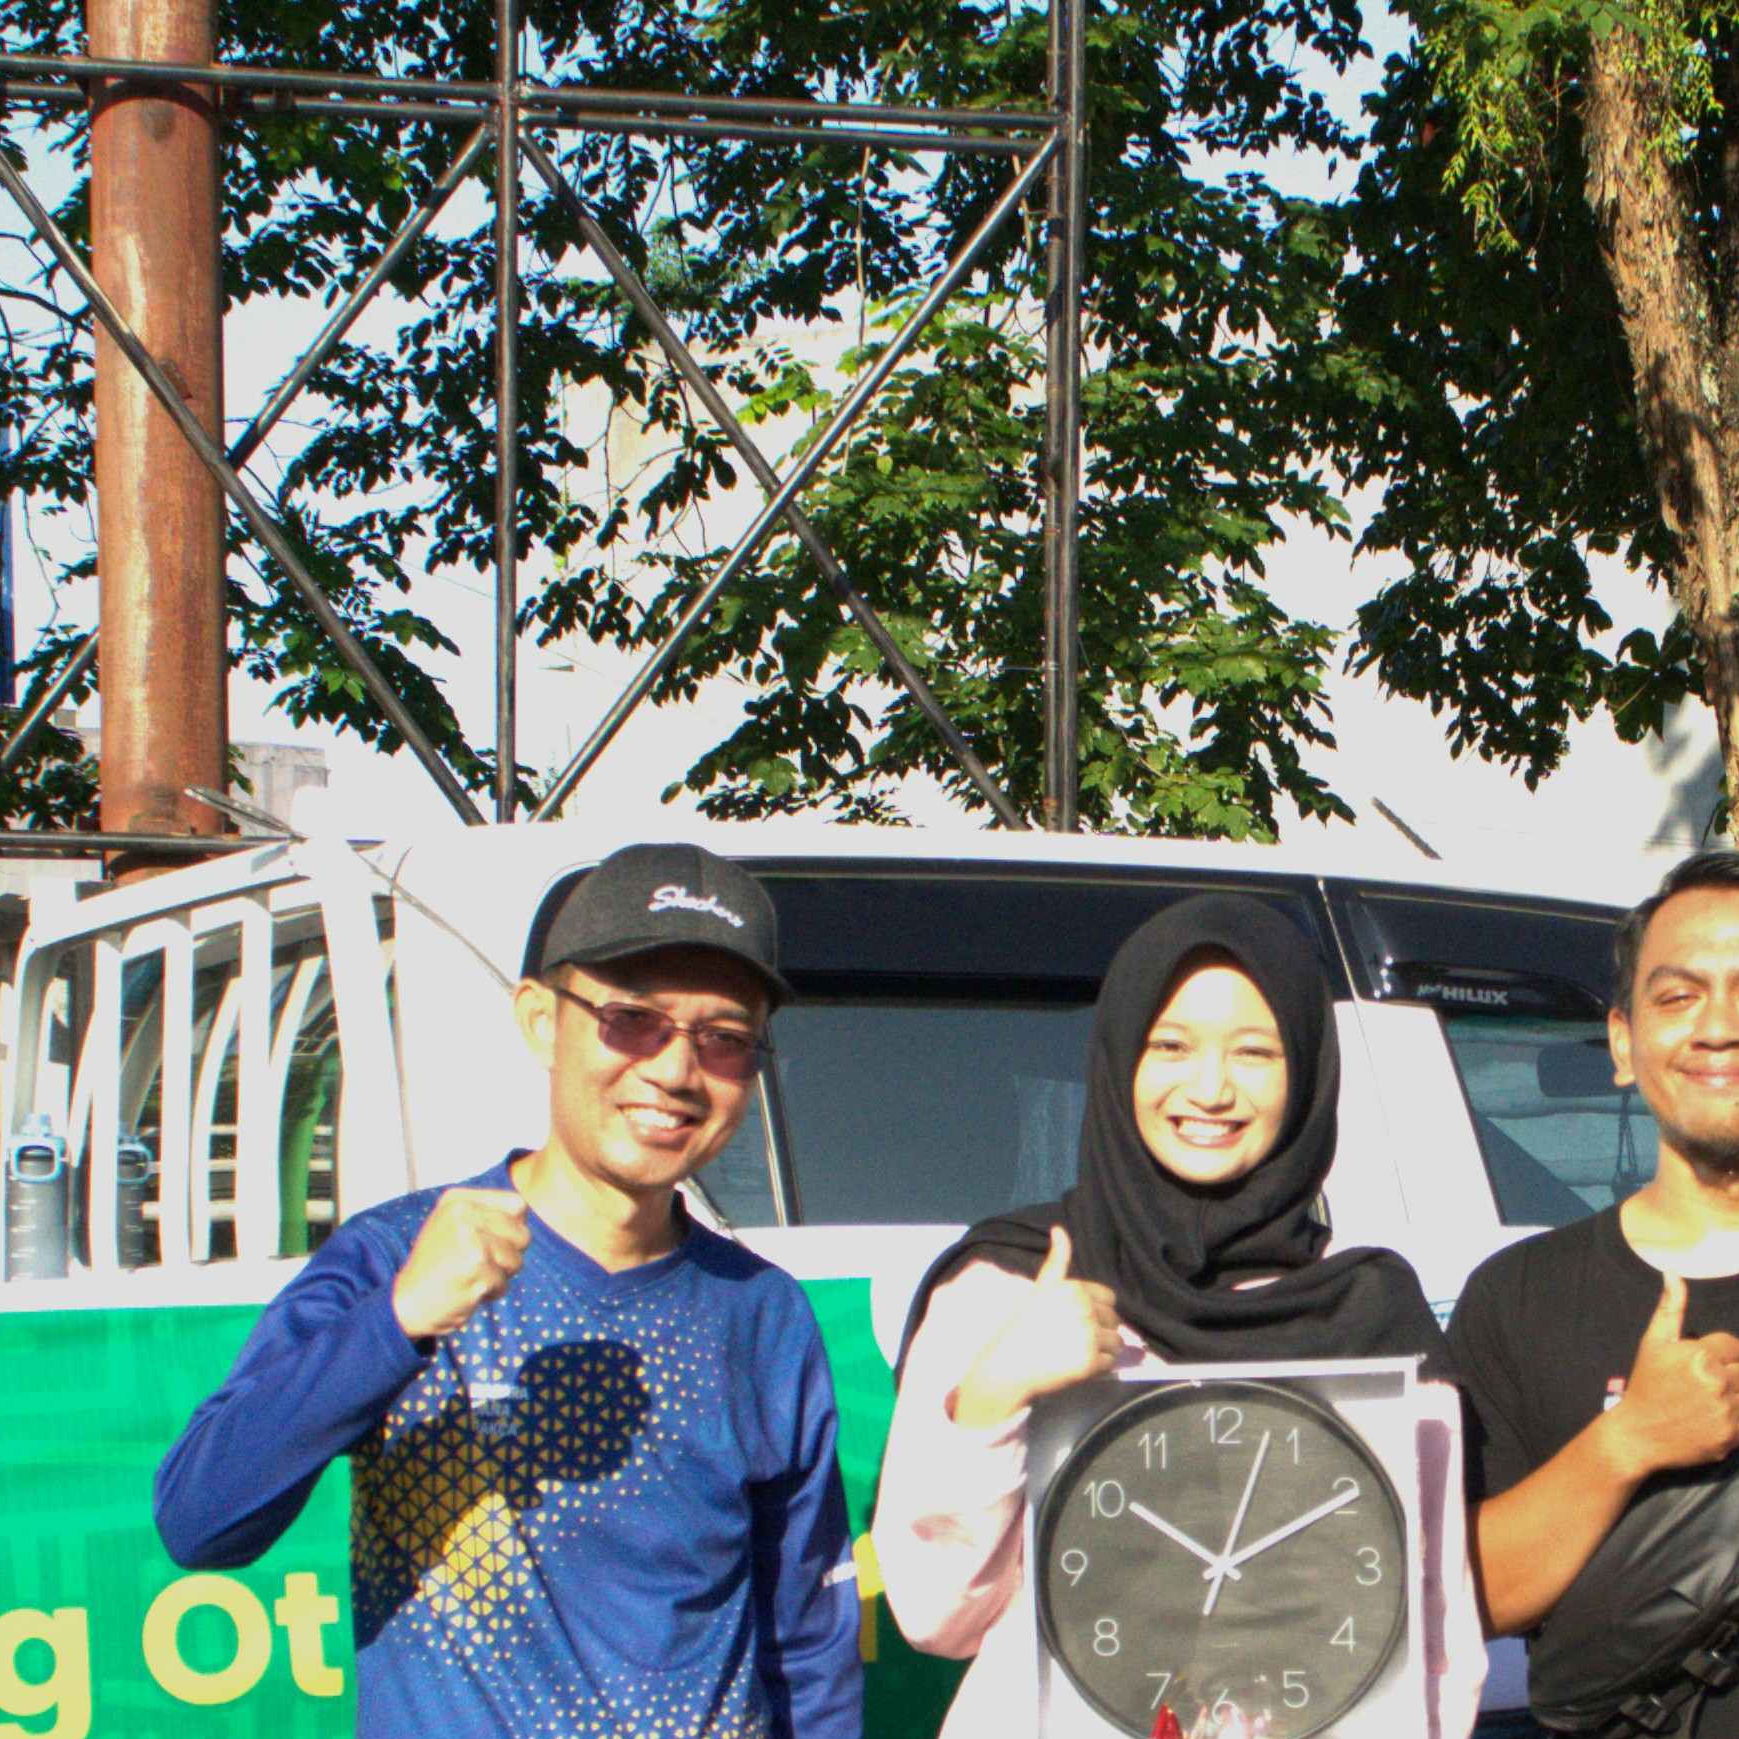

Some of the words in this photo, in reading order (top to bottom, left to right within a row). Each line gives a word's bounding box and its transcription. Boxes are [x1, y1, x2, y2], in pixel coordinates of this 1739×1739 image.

[1442, 985, 1509, 1006] HILUX
[1202, 1406, 1243, 1445] 12
[1138, 1431, 1168, 1470] 11
[1286, 1427, 1301, 1466] 1
[1083, 1480, 1126, 1519] 10
[1060, 1549, 1087, 1587] 9
[1355, 1546, 1382, 1586] 3
[142, 1572, 344, 1706] Ot
[1092, 1618, 1121, 1656] 8
[1329, 1615, 1357, 1655] 4
[1145, 1671, 1173, 1710] 7
[1210, 1688, 1237, 1726] 6
[1282, 1669, 1309, 1708] 5
